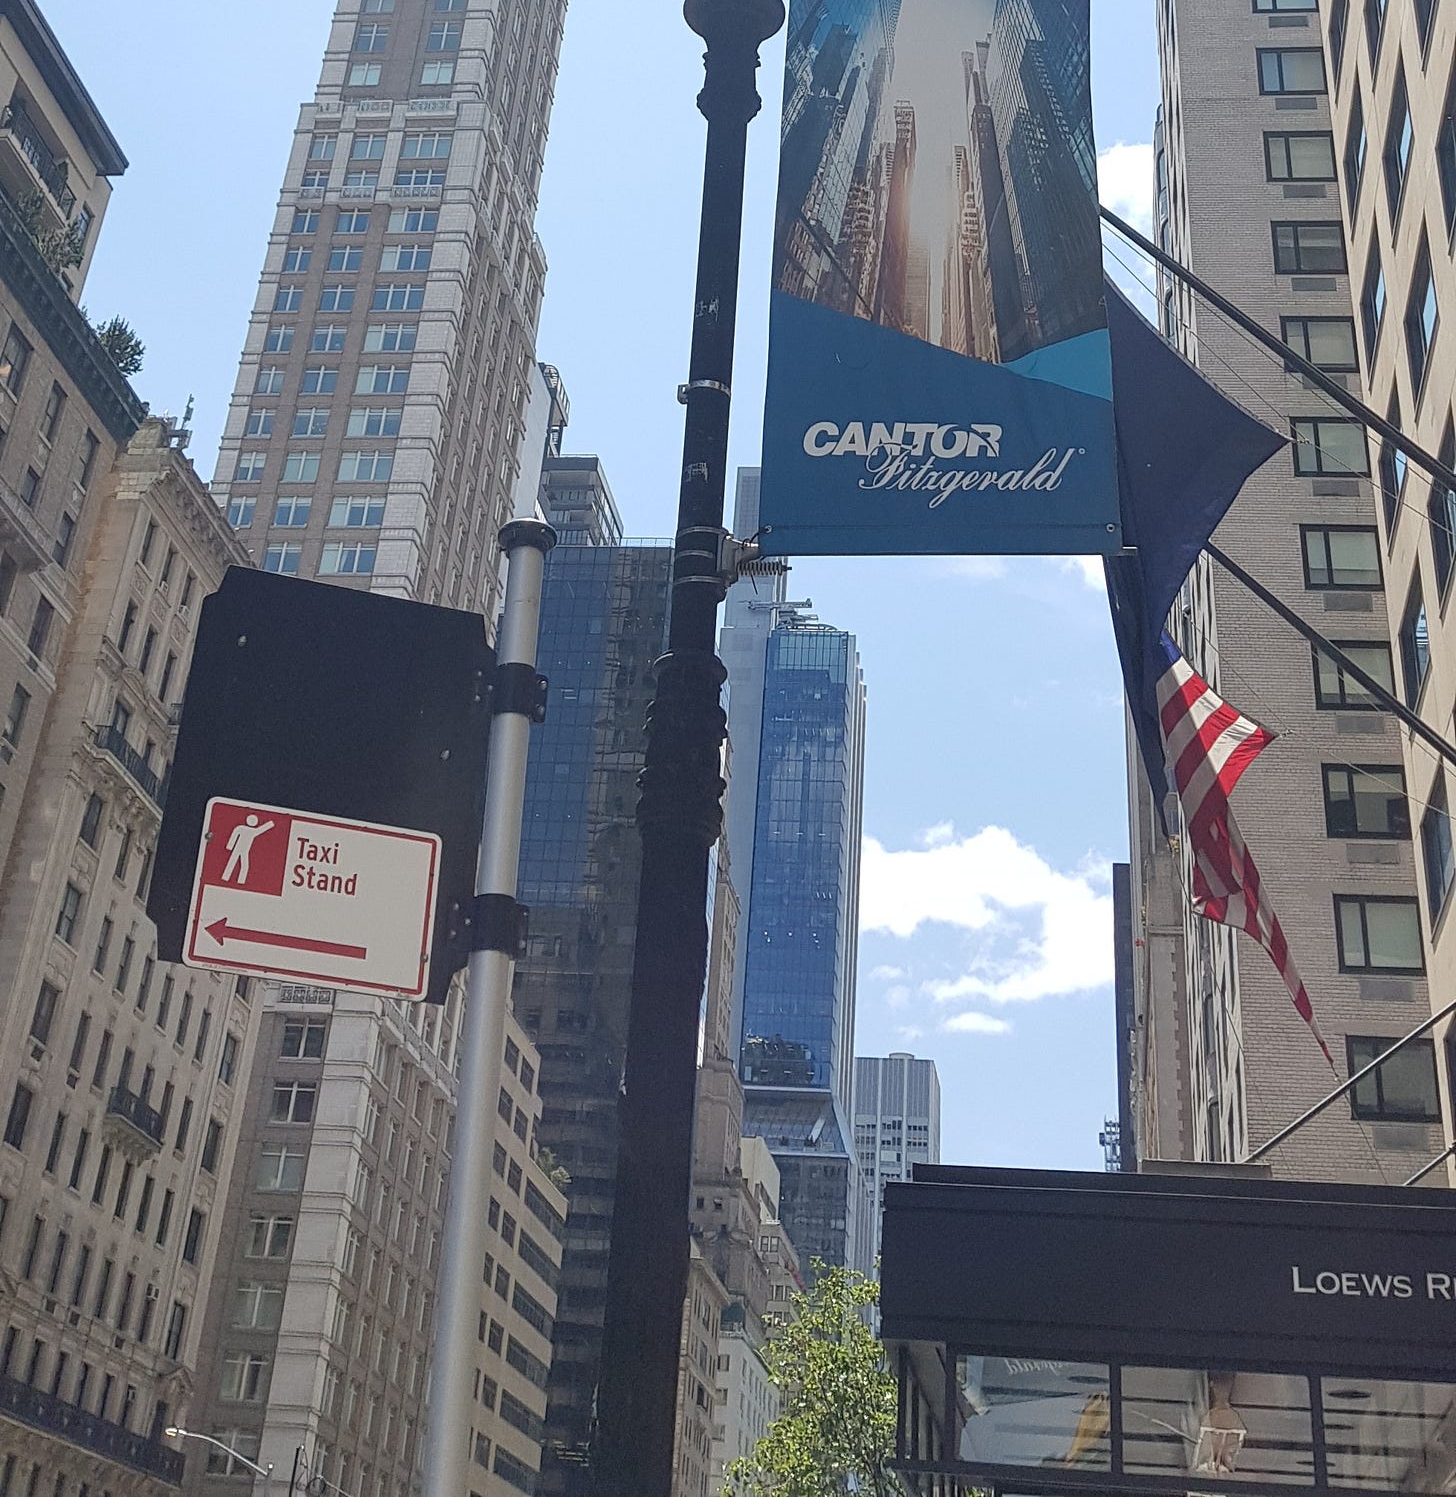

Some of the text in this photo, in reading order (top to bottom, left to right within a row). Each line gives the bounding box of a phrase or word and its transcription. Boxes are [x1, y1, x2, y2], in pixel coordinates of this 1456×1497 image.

[802, 421, 1003, 458] CANTOR
[296, 837, 340, 865] Taxi
[291, 864, 358, 896] Stand
[1291, 1266, 1413, 1298] LOEWS
